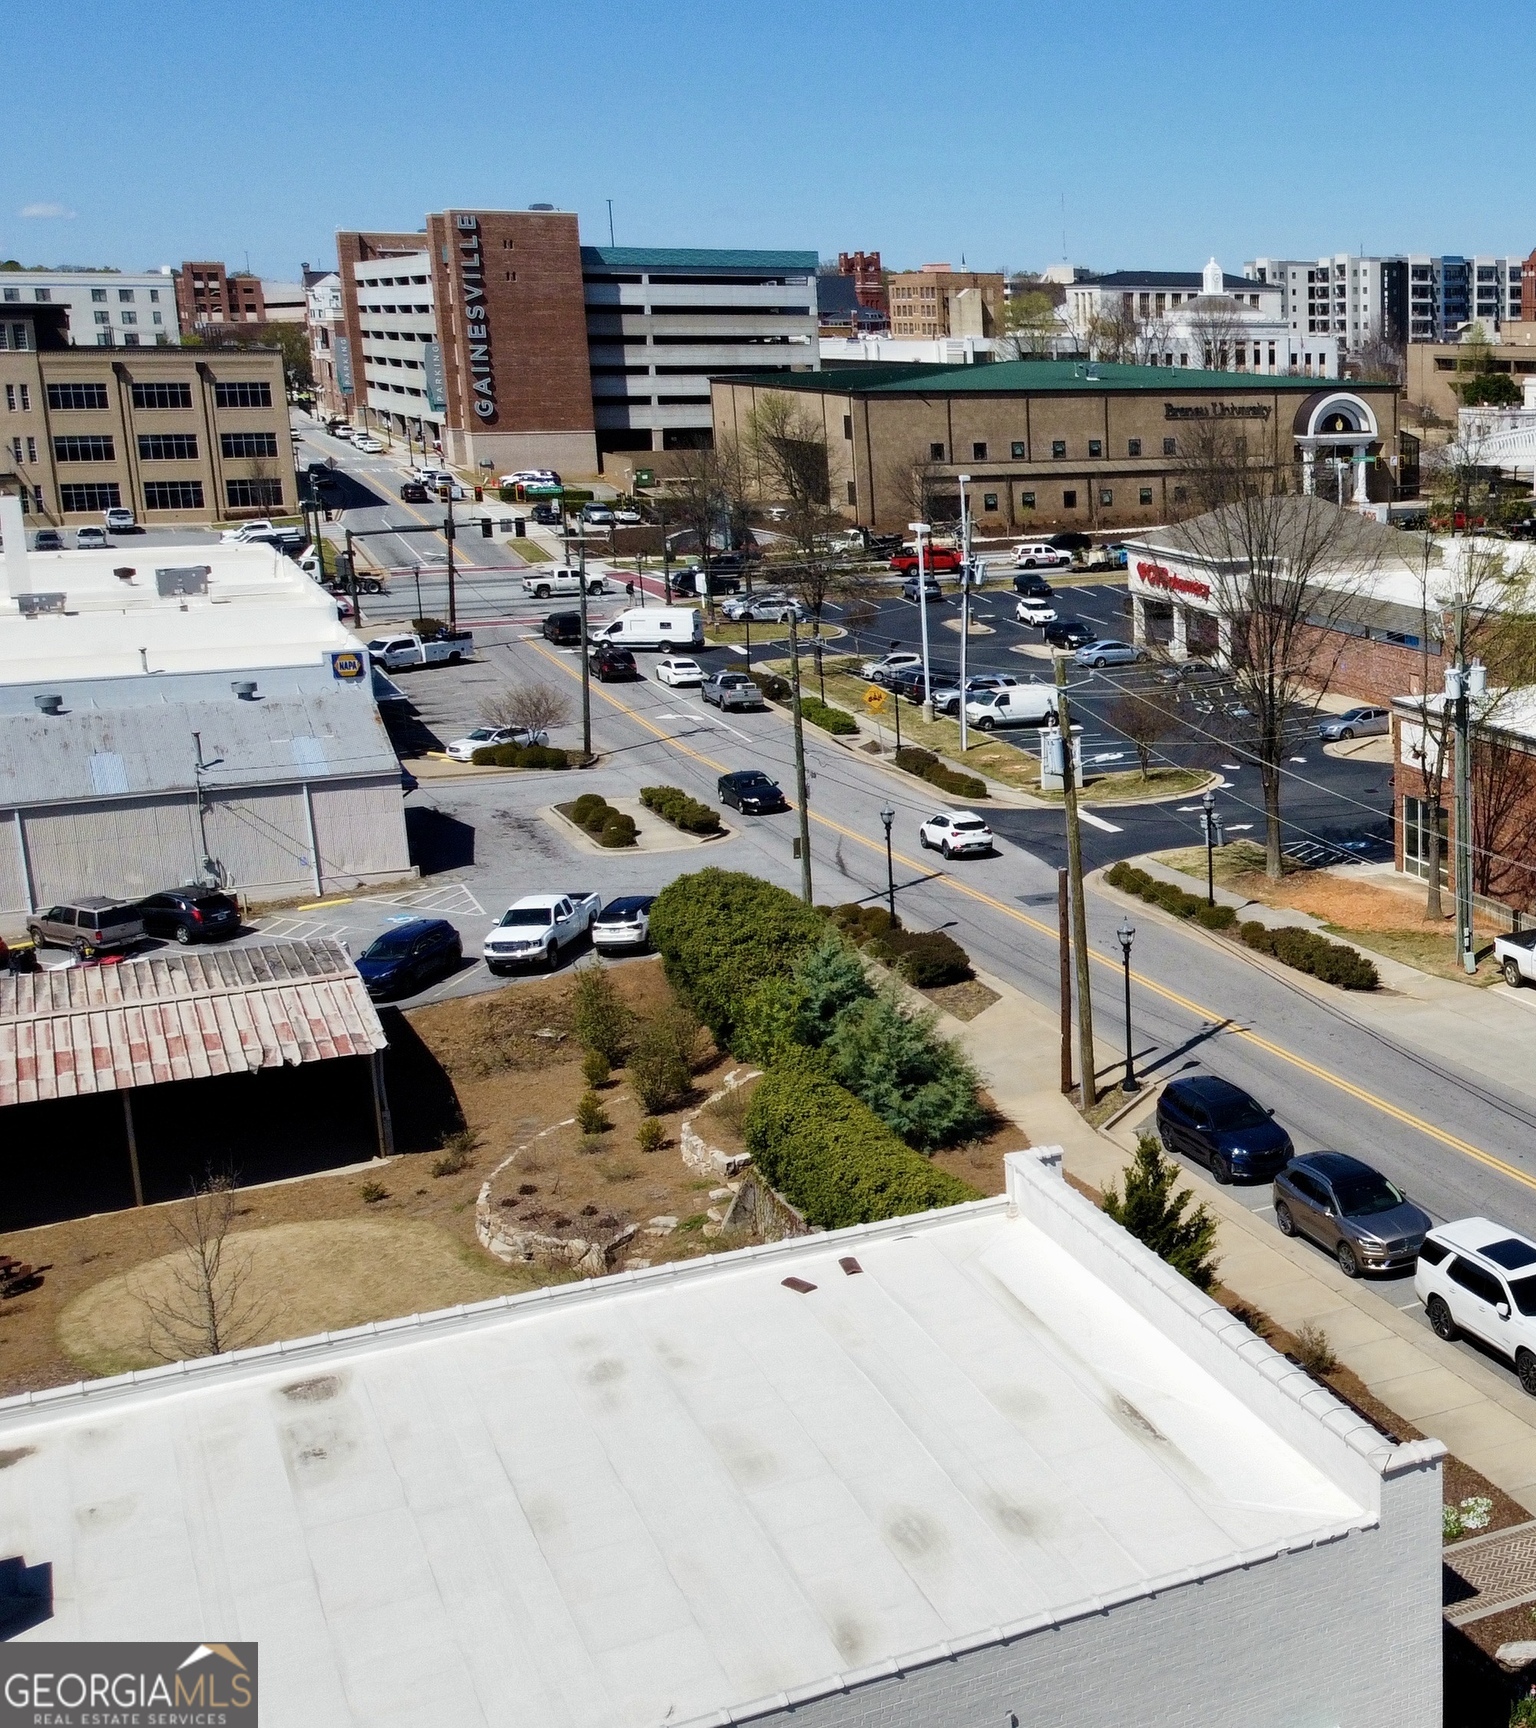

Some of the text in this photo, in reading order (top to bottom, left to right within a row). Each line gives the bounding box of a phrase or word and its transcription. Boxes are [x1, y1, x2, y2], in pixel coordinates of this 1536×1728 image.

[457, 215, 494, 417] GAINESVILLE
[340, 339, 352, 385] PARKING
[432, 345, 444, 402] PARKING
[1211, 402, 1272, 421] University
[339, 661, 357, 670] NAPA
